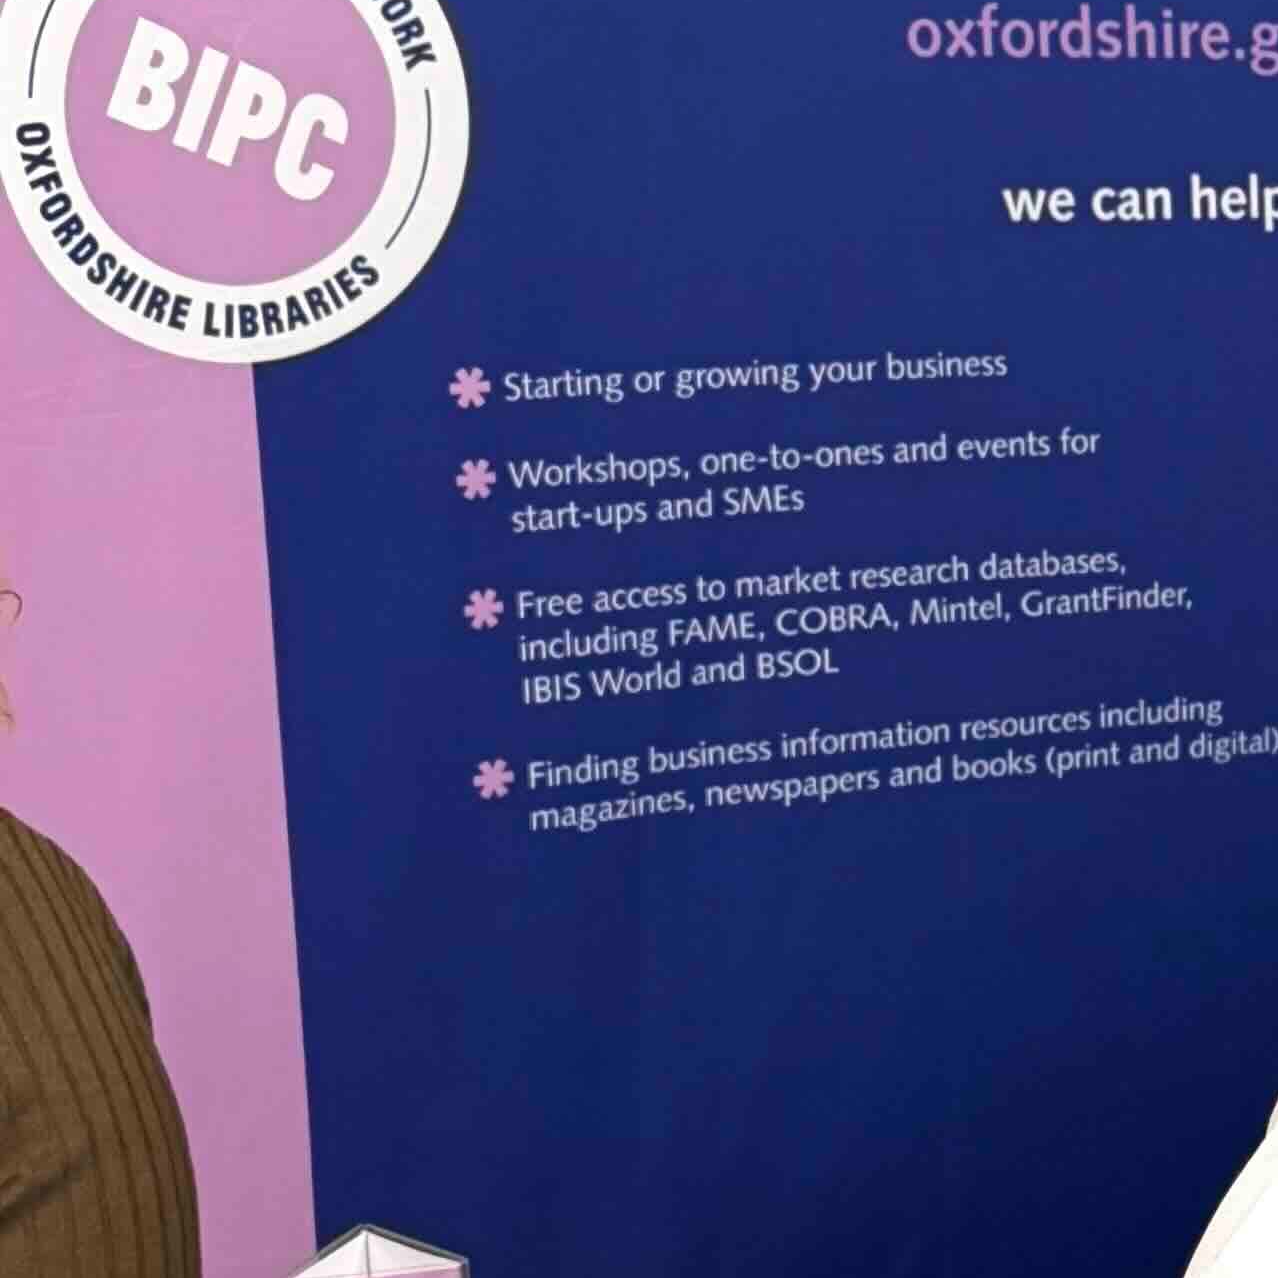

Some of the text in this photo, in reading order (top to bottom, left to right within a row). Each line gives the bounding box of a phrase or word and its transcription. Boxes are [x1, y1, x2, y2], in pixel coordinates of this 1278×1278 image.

[106, 15, 349, 201] BIPC
[16, 122, 380, 339] OXFORDSHIRE LIBRARIES
[1003, 188, 1074, 221] we
[1093, 188, 1171, 220] can
[505, 352, 1007, 406] Starting or growing your business
[509, 427, 1099, 488] Workshops, one-to-ones and events for
[512, 485, 804, 533] start-ups and SMEs
[519, 550, 1125, 618] Free access to market research databases,
[521, 582, 1192, 661] including FAME, COBRA, Mintel, GrantFinder,
[525, 648, 838, 704] IBIS World and BSOL
[529, 697, 1222, 789] Finding business information resources including
[532, 791, 694, 831] magazines,
[706, 770, 879, 806] newspapers
[890, 756, 941, 787] and
[953, 749, 1036, 780] books
[1046, 743, 1120, 778] (print
[1130, 734, 1183, 764] and
